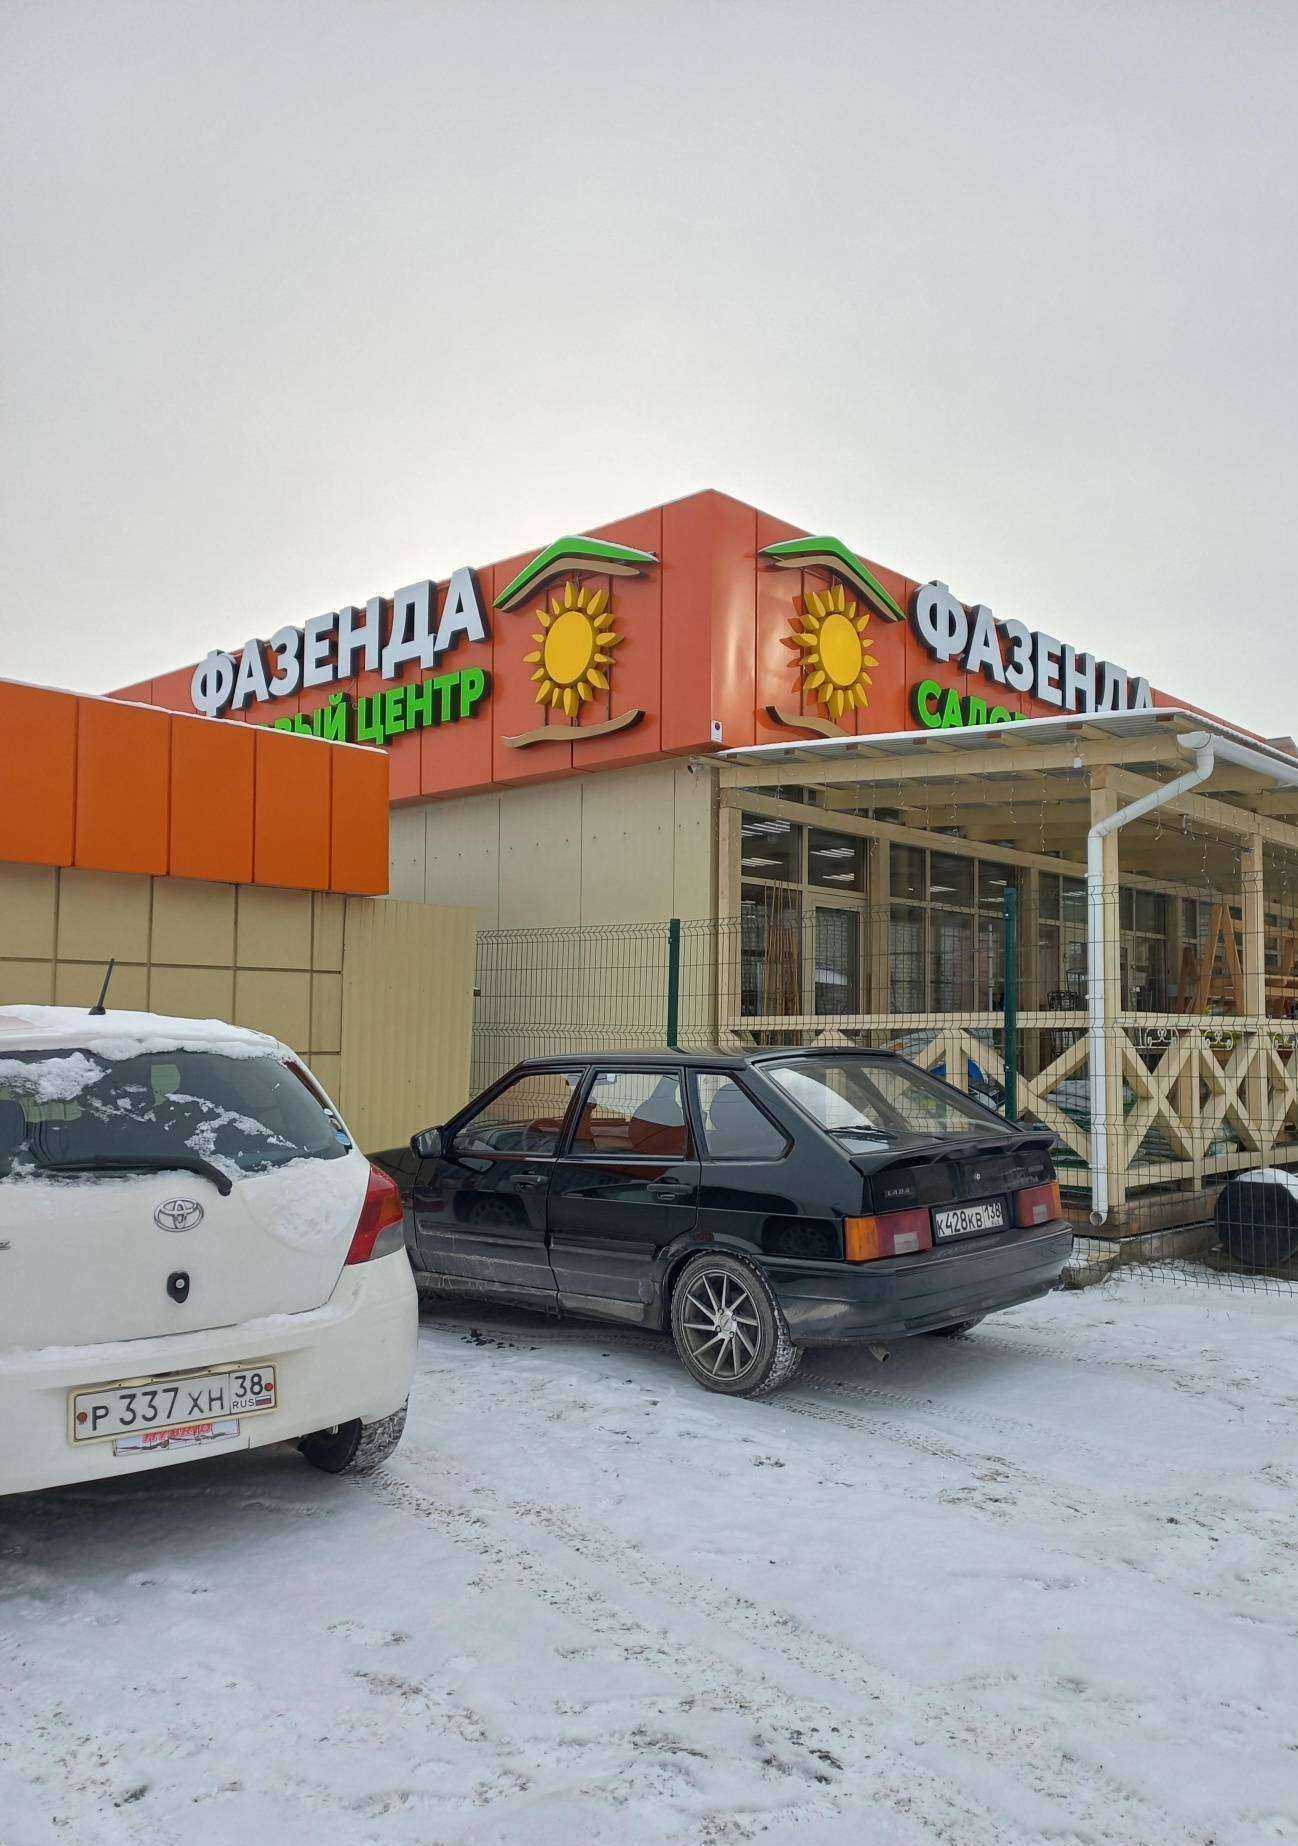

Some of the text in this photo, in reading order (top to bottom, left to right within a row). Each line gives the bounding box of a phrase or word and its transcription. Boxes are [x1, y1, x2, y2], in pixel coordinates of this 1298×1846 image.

[191, 566, 487, 717] ФАЗЕНДА
[357, 667, 486, 745] ЦЕНТР
[232, 1398, 255, 1409] RUS
[234, 1373, 264, 1398] 38
